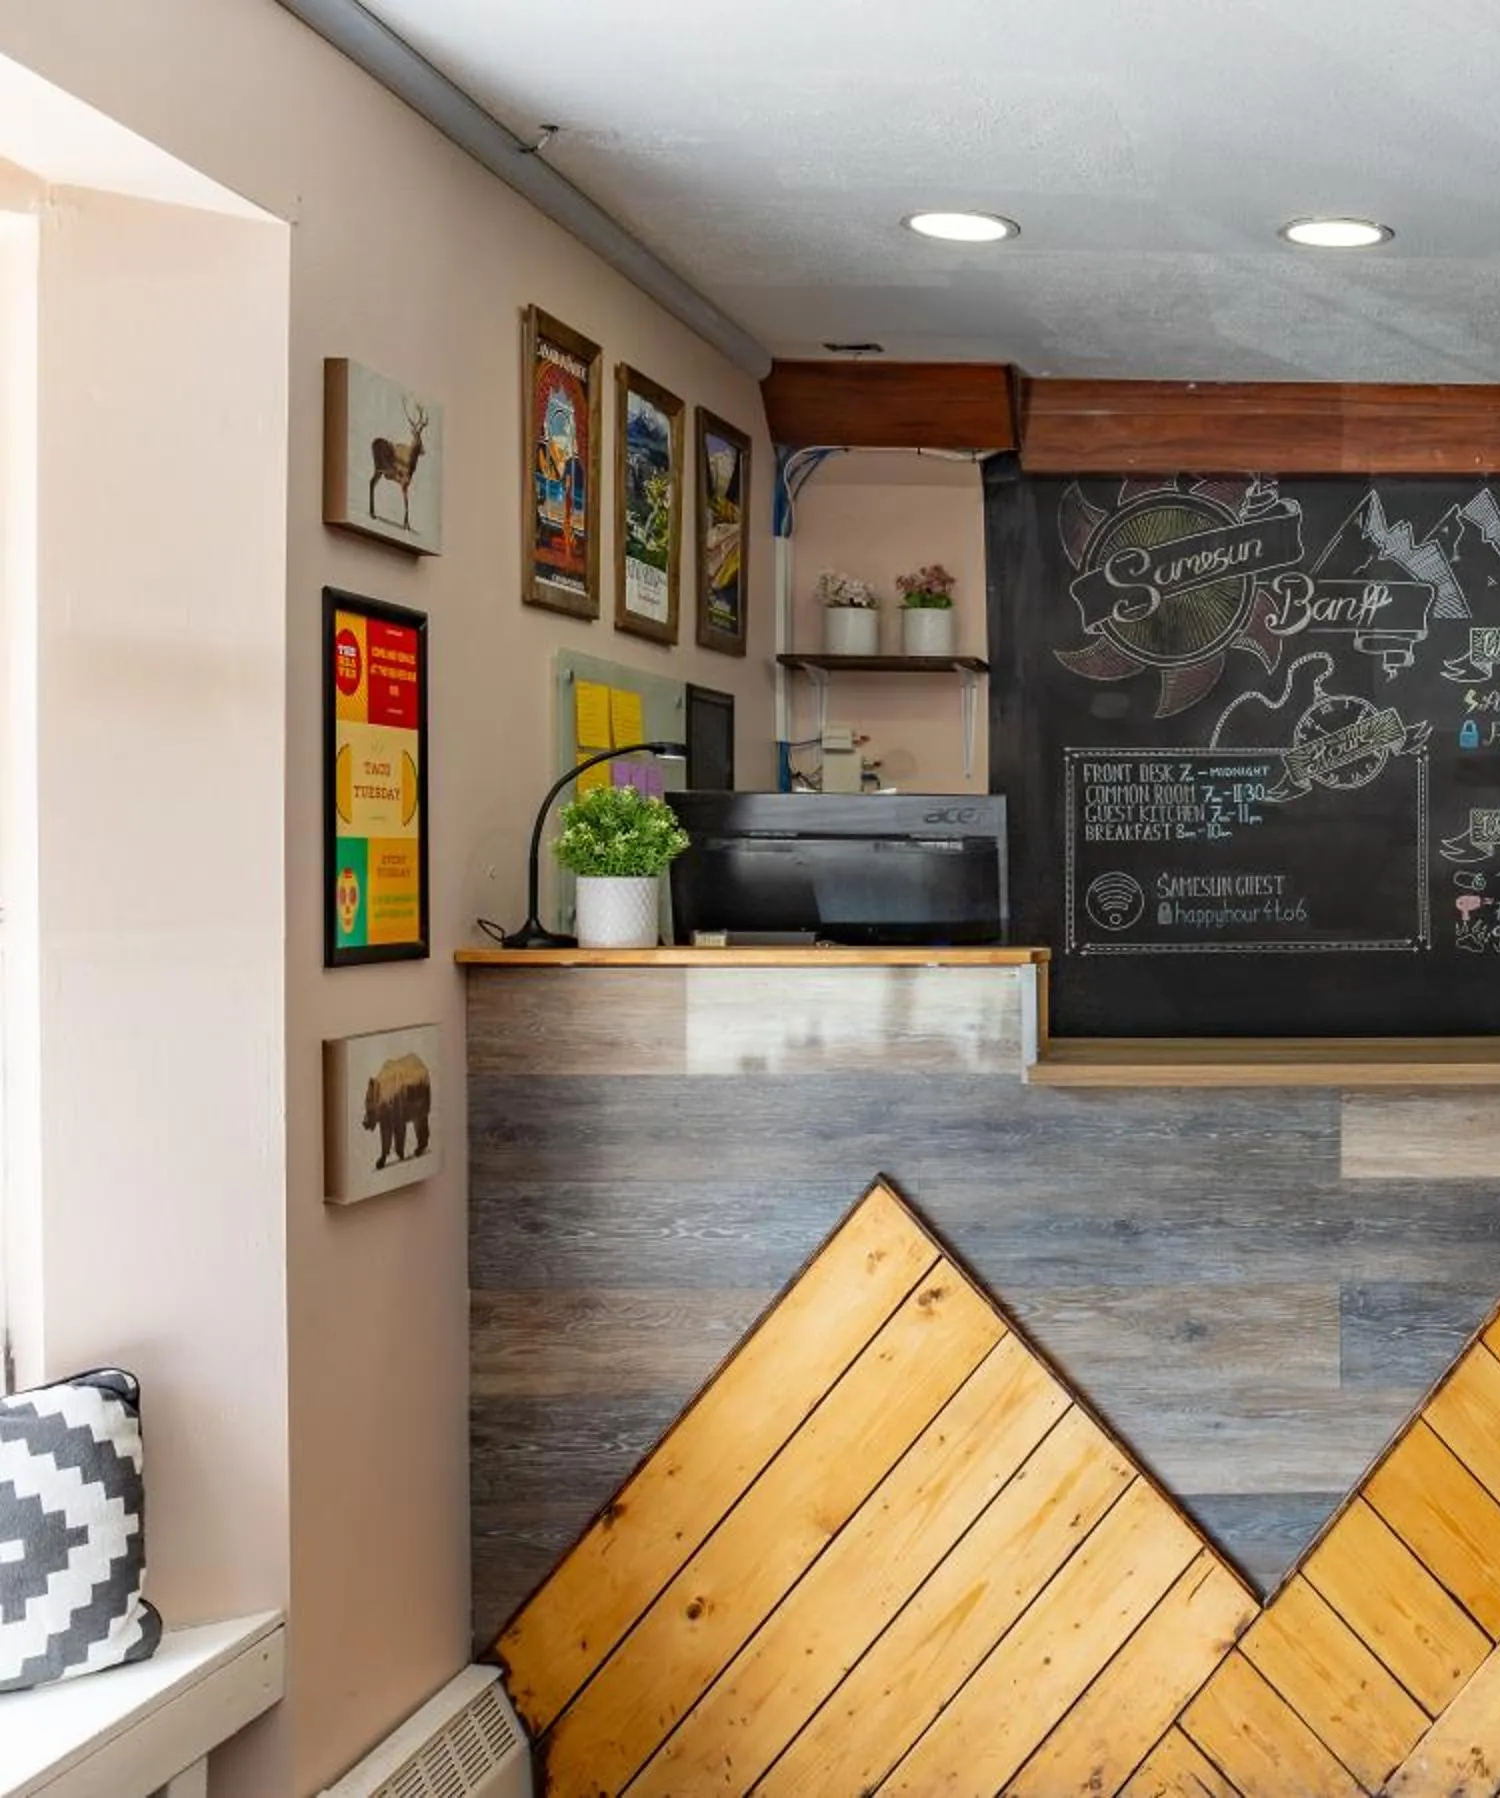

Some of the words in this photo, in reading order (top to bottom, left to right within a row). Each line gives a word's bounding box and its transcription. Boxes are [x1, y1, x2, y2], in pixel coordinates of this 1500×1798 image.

[1105, 537, 1262, 622] Samesun
[1265, 572, 1392, 635] Banff
[364, 762, 391, 777] TACO
[1083, 764, 1132, 783] FRONT
[1139, 764, 1174, 783] DESK
[353, 785, 401, 801] TUESDAY
[1085, 784, 1149, 804] COMMON
[1154, 784, 1195, 804] ROOM
[1085, 805, 1132, 823] GUEST
[1140, 804, 1205, 823] KITCHEN
[1085, 823, 1172, 841] BREAKFAST
[1235, 875, 1285, 895] GUEST
